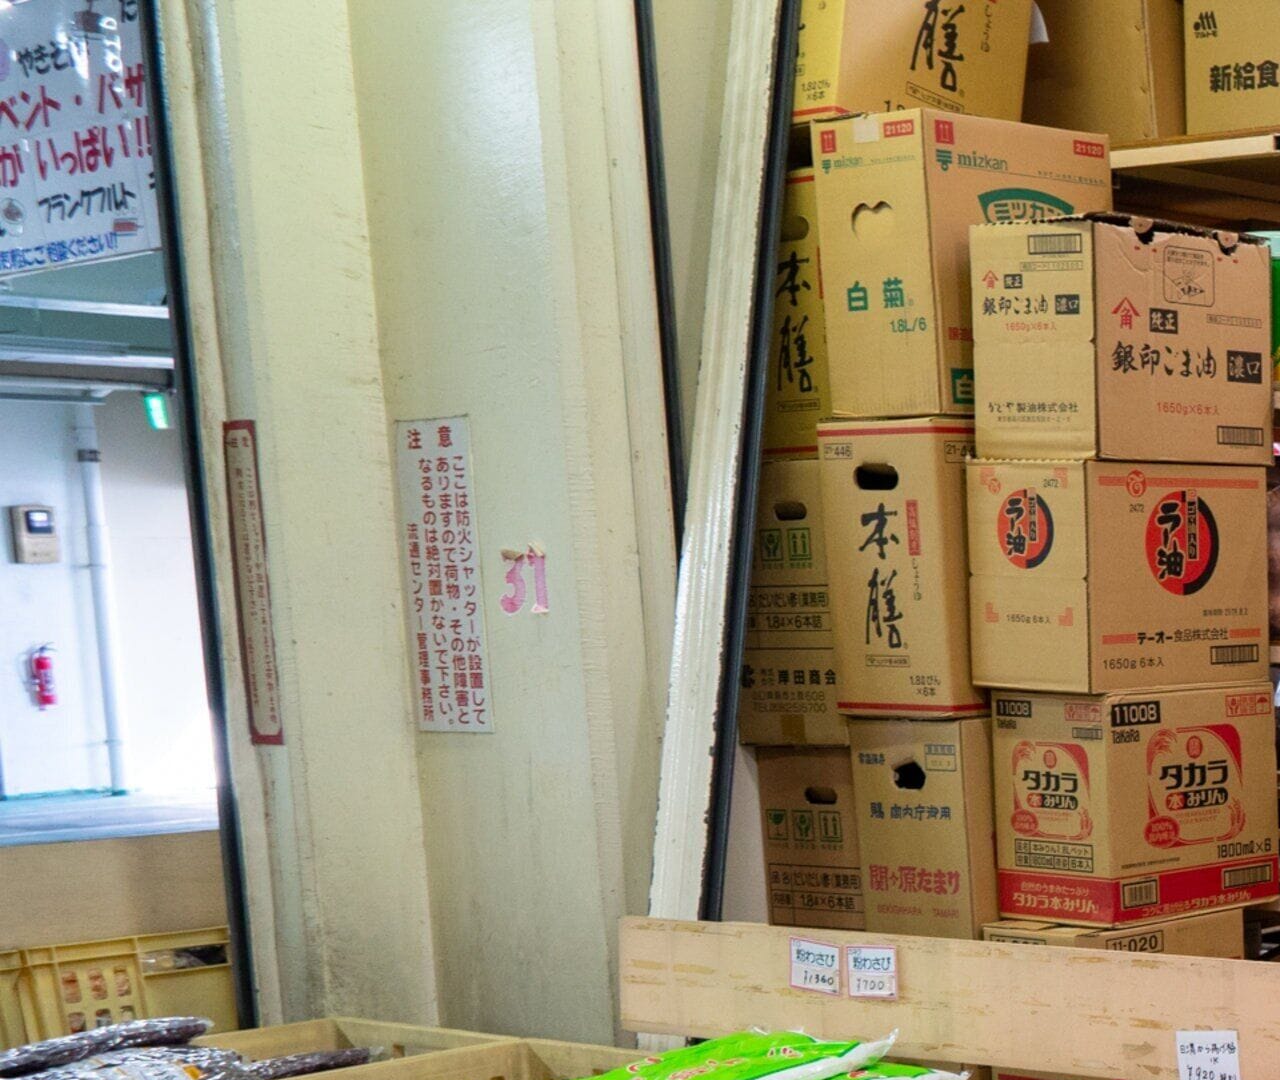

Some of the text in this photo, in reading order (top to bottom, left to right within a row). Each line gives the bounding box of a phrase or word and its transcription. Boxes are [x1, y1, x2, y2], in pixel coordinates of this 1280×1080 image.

[884, 121, 913, 136] 21120
[957, 150, 1008, 171] mizkan
[846, 277, 904, 312] 白菊
[1150, 309, 1178, 333] 純正
[1228, 351, 1262, 383] 濃口
[406, 425, 453, 450] 注意
[1004, 497, 1028, 556] ラー油
[1155, 501, 1187, 581] ラー油
[500, 542, 550, 615] 31
[1136, 628, 1229, 645] テーオー食品株式会社
[1102, 658, 1137, 671] 1650g
[998, 701, 1030, 717] 11008
[1113, 703, 1158, 725] 11008
[1022, 769, 1079, 793] タカラ
[1159, 760, 1229, 790] タカラ
[1026, 793, 1079, 811] 本みりん
[1166, 787, 1229, 811] 本みりん
